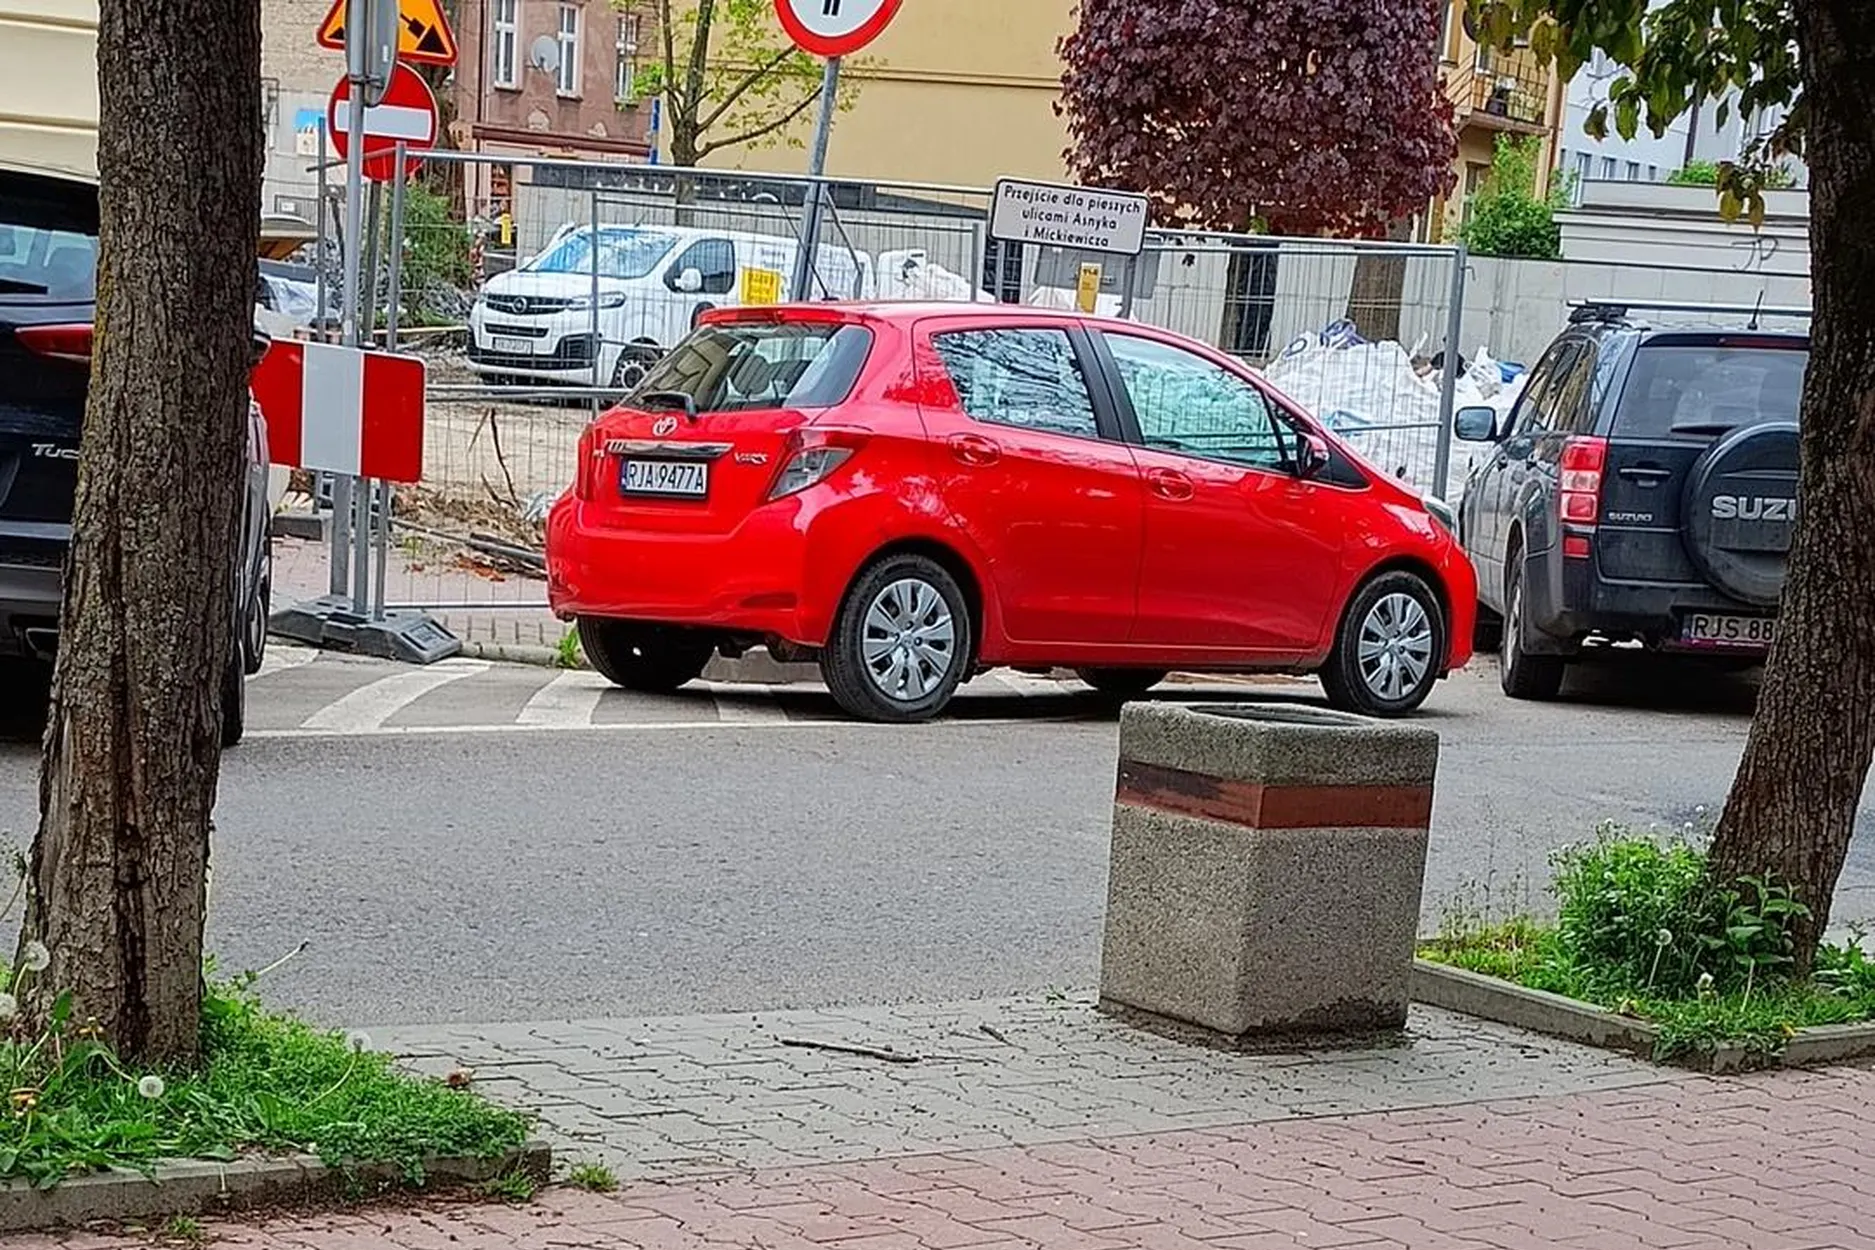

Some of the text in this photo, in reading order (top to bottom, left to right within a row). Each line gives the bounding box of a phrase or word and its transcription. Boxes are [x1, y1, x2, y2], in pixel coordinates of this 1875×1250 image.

[1004, 185, 1140, 215] Przejście dla pieszych
[1022, 208, 1117, 230] ulicami Asnyka
[1024, 225, 1109, 247] i Mickiewicza
[628, 463, 704, 491] RJA 9477A
[1711, 495, 1797, 521] SUZ
[1694, 616, 1775, 640] RJS 88
